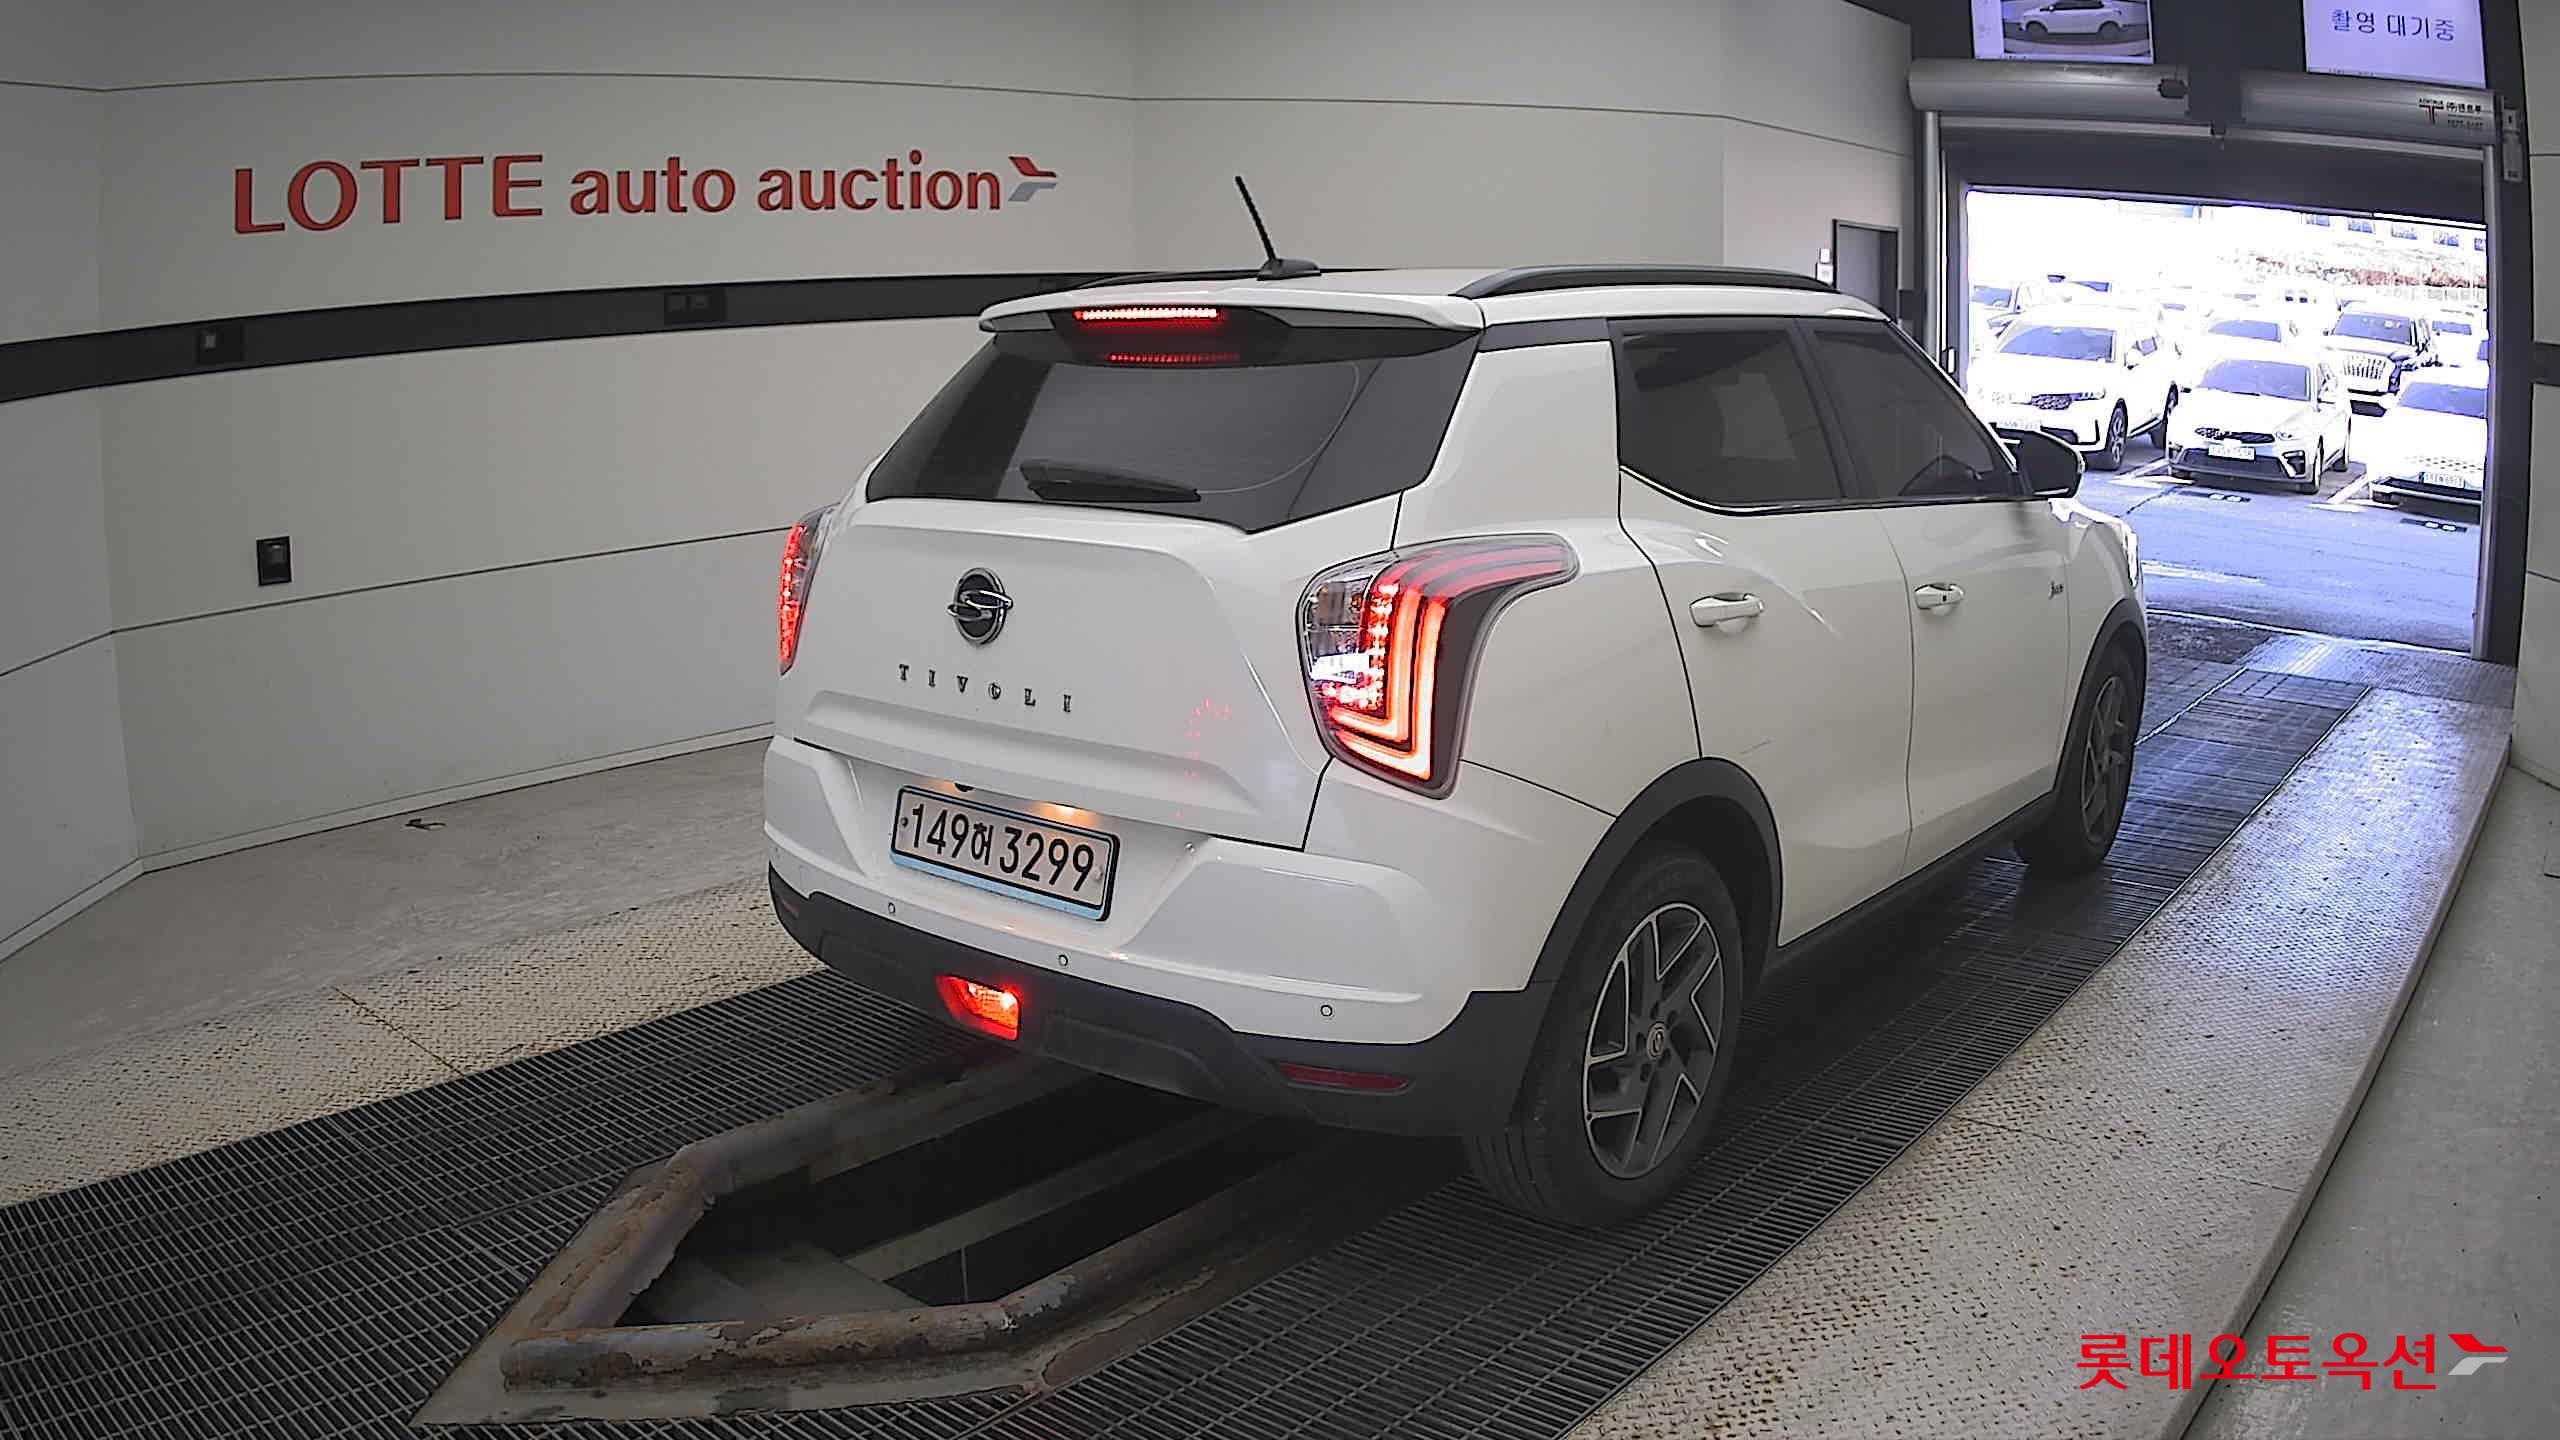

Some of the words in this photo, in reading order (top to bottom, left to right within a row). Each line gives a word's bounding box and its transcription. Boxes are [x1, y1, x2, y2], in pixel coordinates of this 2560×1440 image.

[2331, 9, 2376, 34] 촬영
[2386, 14, 2456, 42] 대기중
[235, 154, 543, 234] LOTTE
[570, 156, 737, 216] auto
[759, 149, 1002, 212] auction
[898, 662, 1073, 714] TIVOLI
